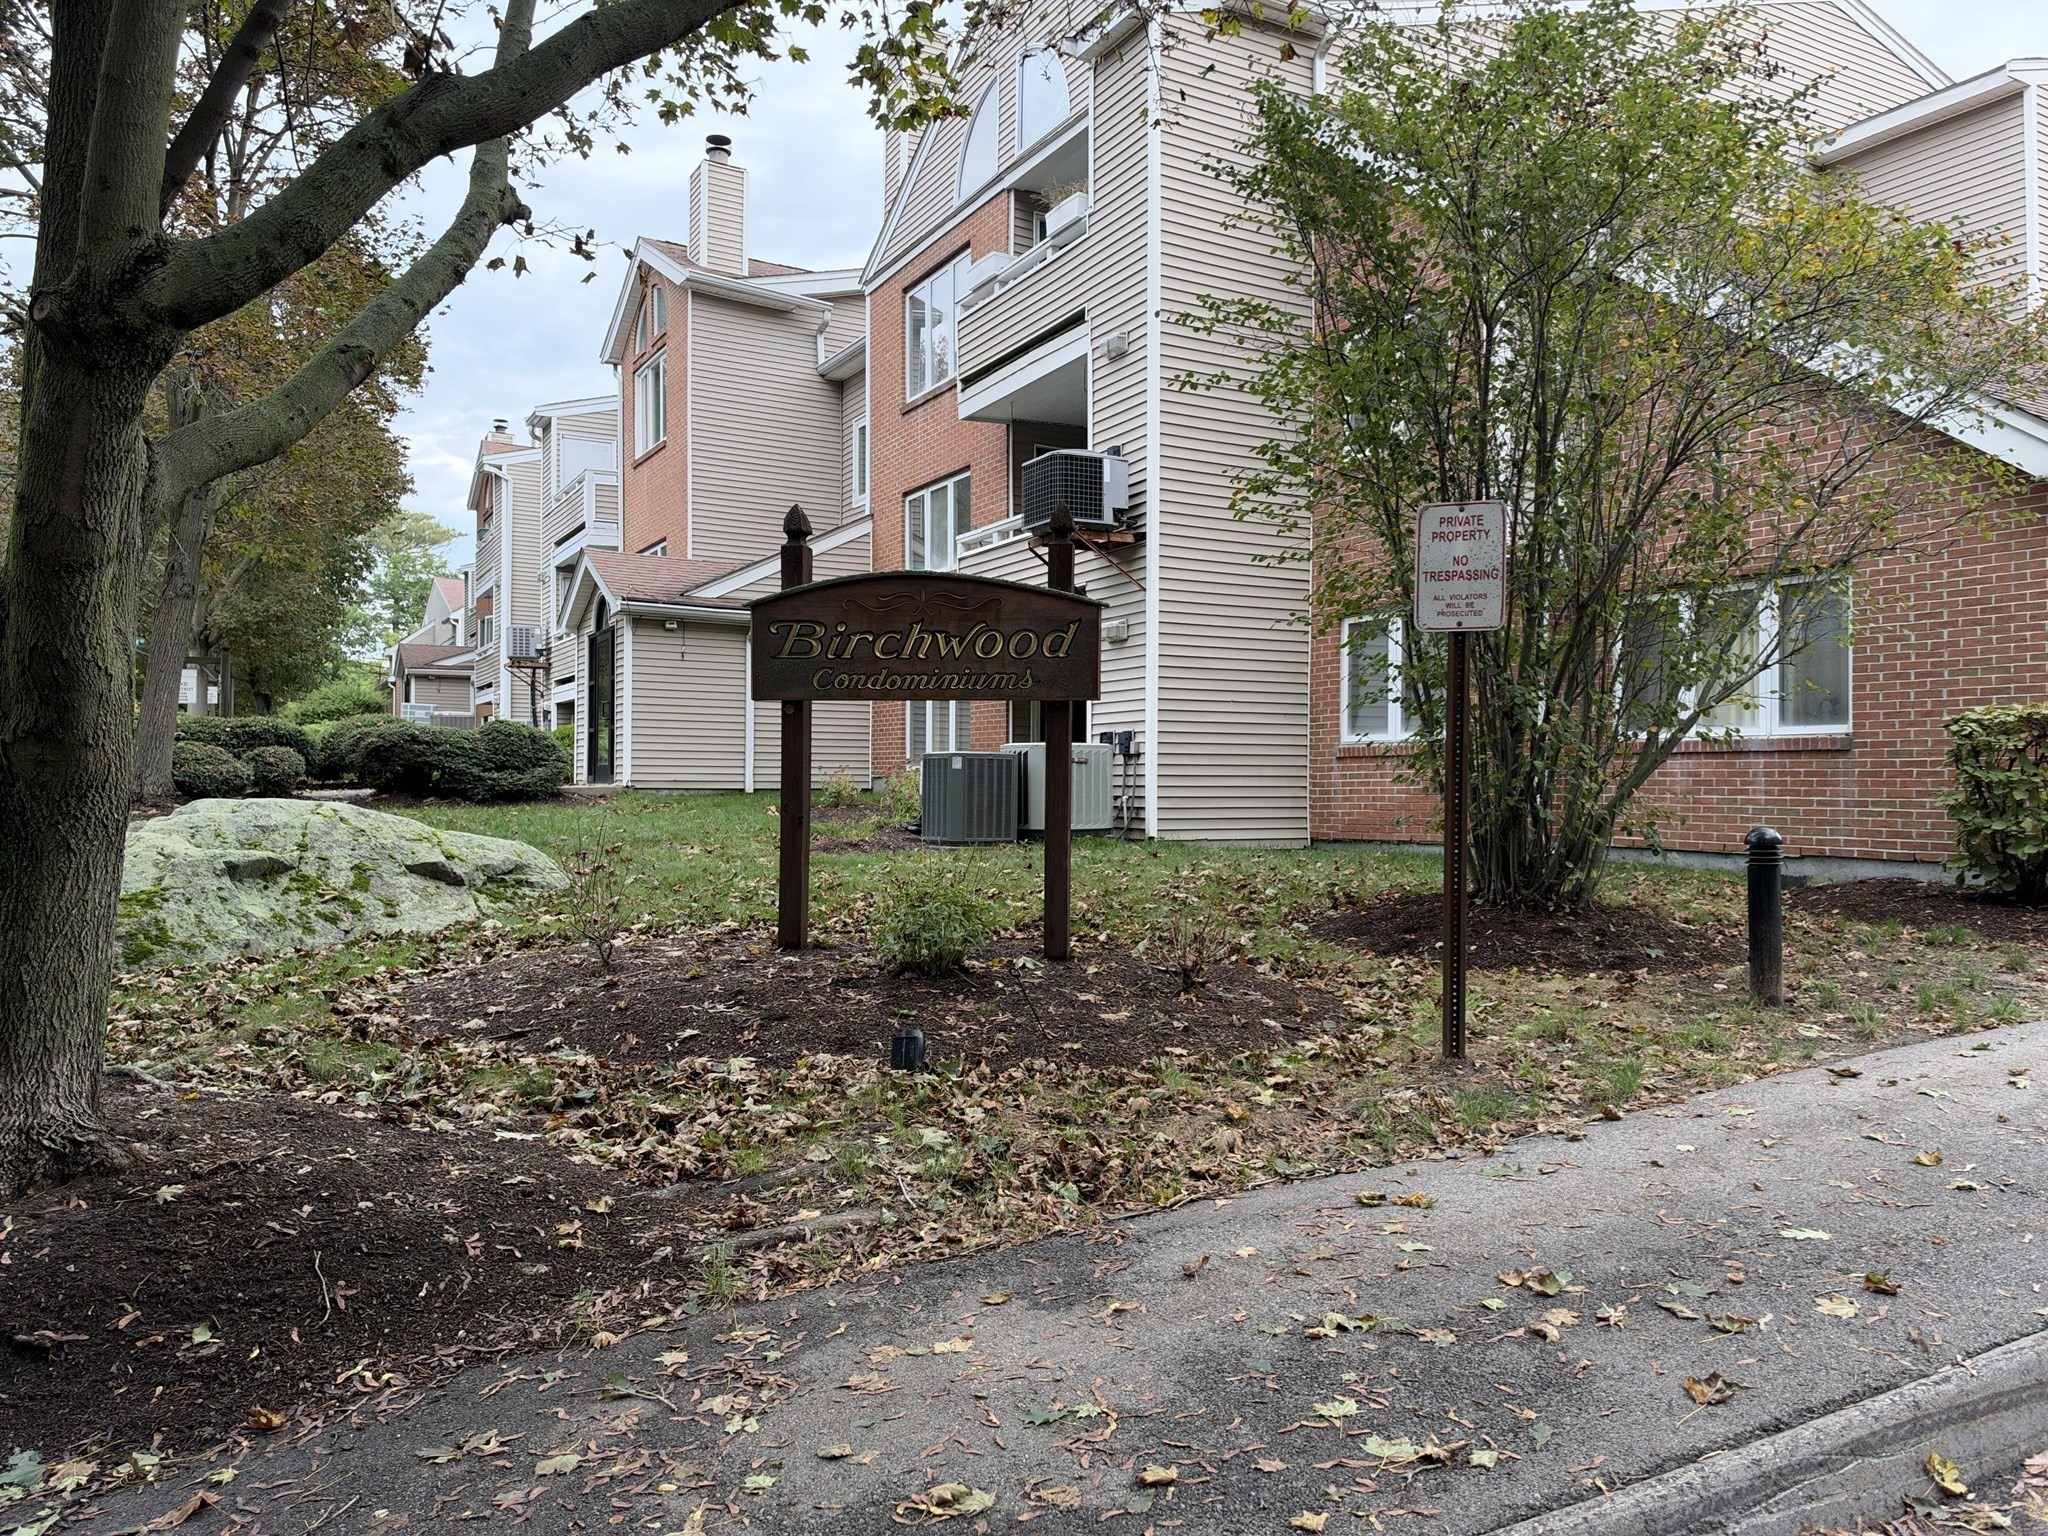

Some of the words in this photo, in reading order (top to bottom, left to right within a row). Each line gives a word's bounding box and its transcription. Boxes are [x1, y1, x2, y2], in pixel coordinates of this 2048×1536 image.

[1439, 514, 1484, 528] PRIVATE
[1431, 529, 1491, 543] PROPERTY
[1452, 555, 1469, 567] NO
[1423, 568, 1499, 583] TRESPASSING
[1433, 594, 1446, 602] ALL
[1449, 593, 1488, 601] VIOLATORS
[1465, 601, 1475, 609] BE
[1436, 609, 1483, 618] PROSECUTED
[769, 618, 1083, 661] Birchwood
[811, 666, 1038, 691] Condominiums
